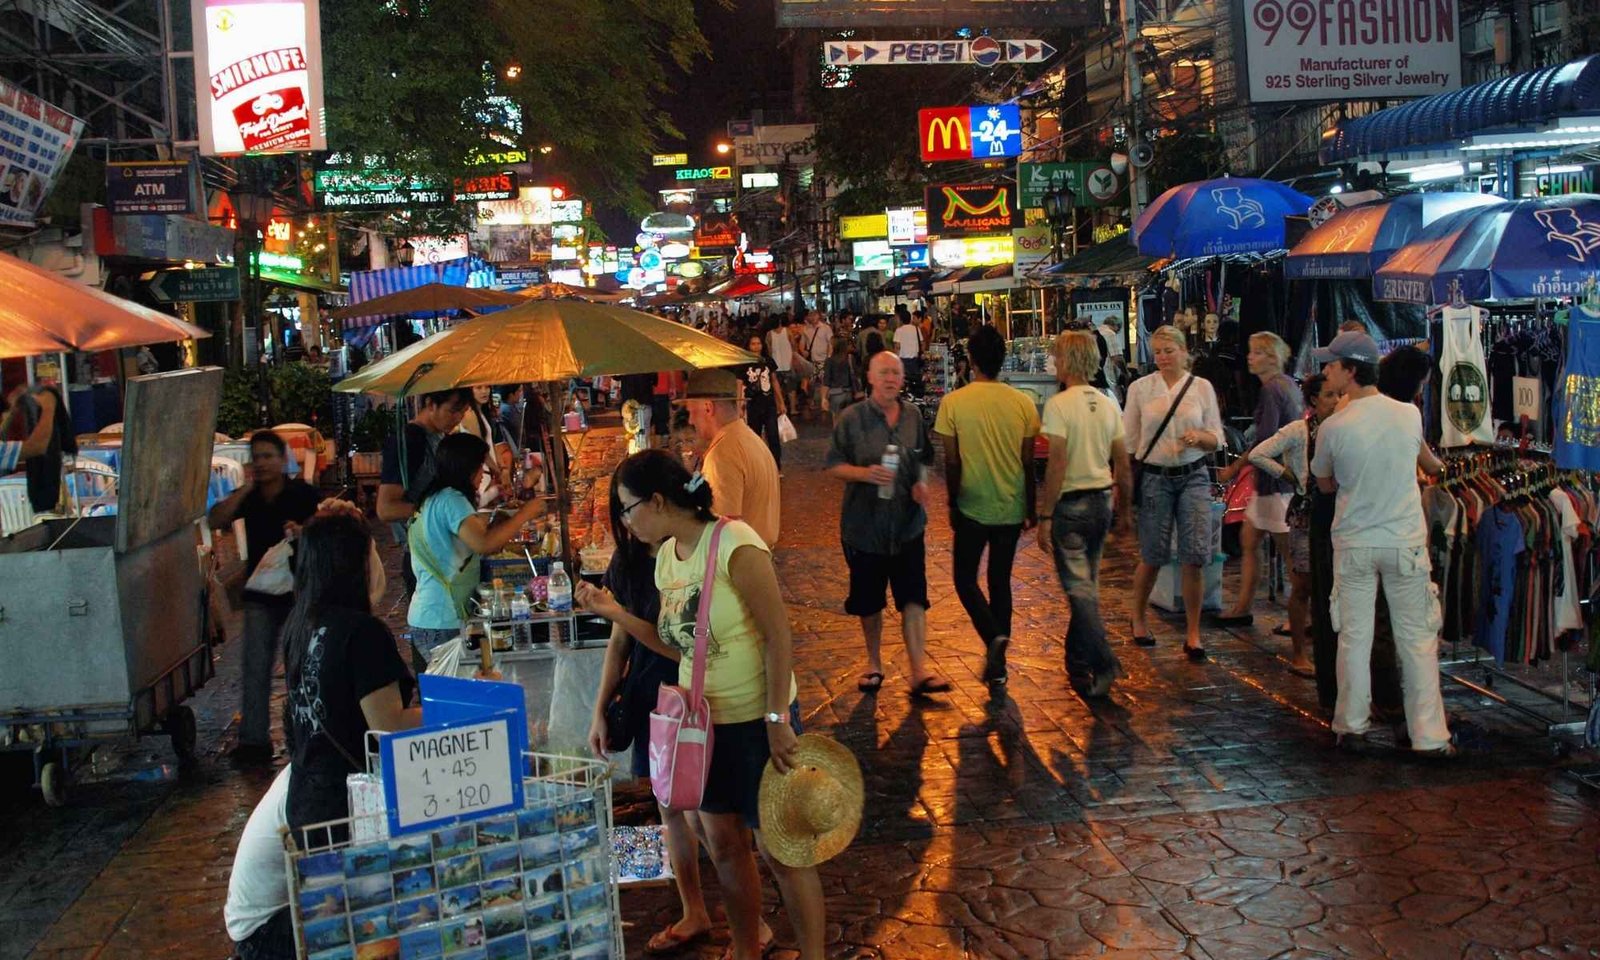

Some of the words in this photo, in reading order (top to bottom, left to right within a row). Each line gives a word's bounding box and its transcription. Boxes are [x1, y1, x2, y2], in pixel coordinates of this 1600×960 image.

[888, 43, 964, 62] PEPSI
[1300, 57, 1392, 71] Manufacturer
[1395, 55, 1409, 69] of
[1265, 76, 1292, 89] 925
[1296, 73, 1350, 89] Sterling
[1353, 72, 1392, 86] Silver
[1395, 71, 1449, 87] Jewelry
[979, 120, 1007, 142] 24
[1051, 169, 1075, 179] ATM
[134, 183, 166, 196] ATM
[1079, 302, 1108, 310] WHATS
[1110, 302, 1121, 310] ON
[1518, 387, 1534, 407] 100
[409, 728, 493, 762] MAGNET
[422, 768, 432, 785] 1
[452, 757, 477, 778] 45
[423, 794, 438, 818] 3
[456, 783, 491, 809] 120
